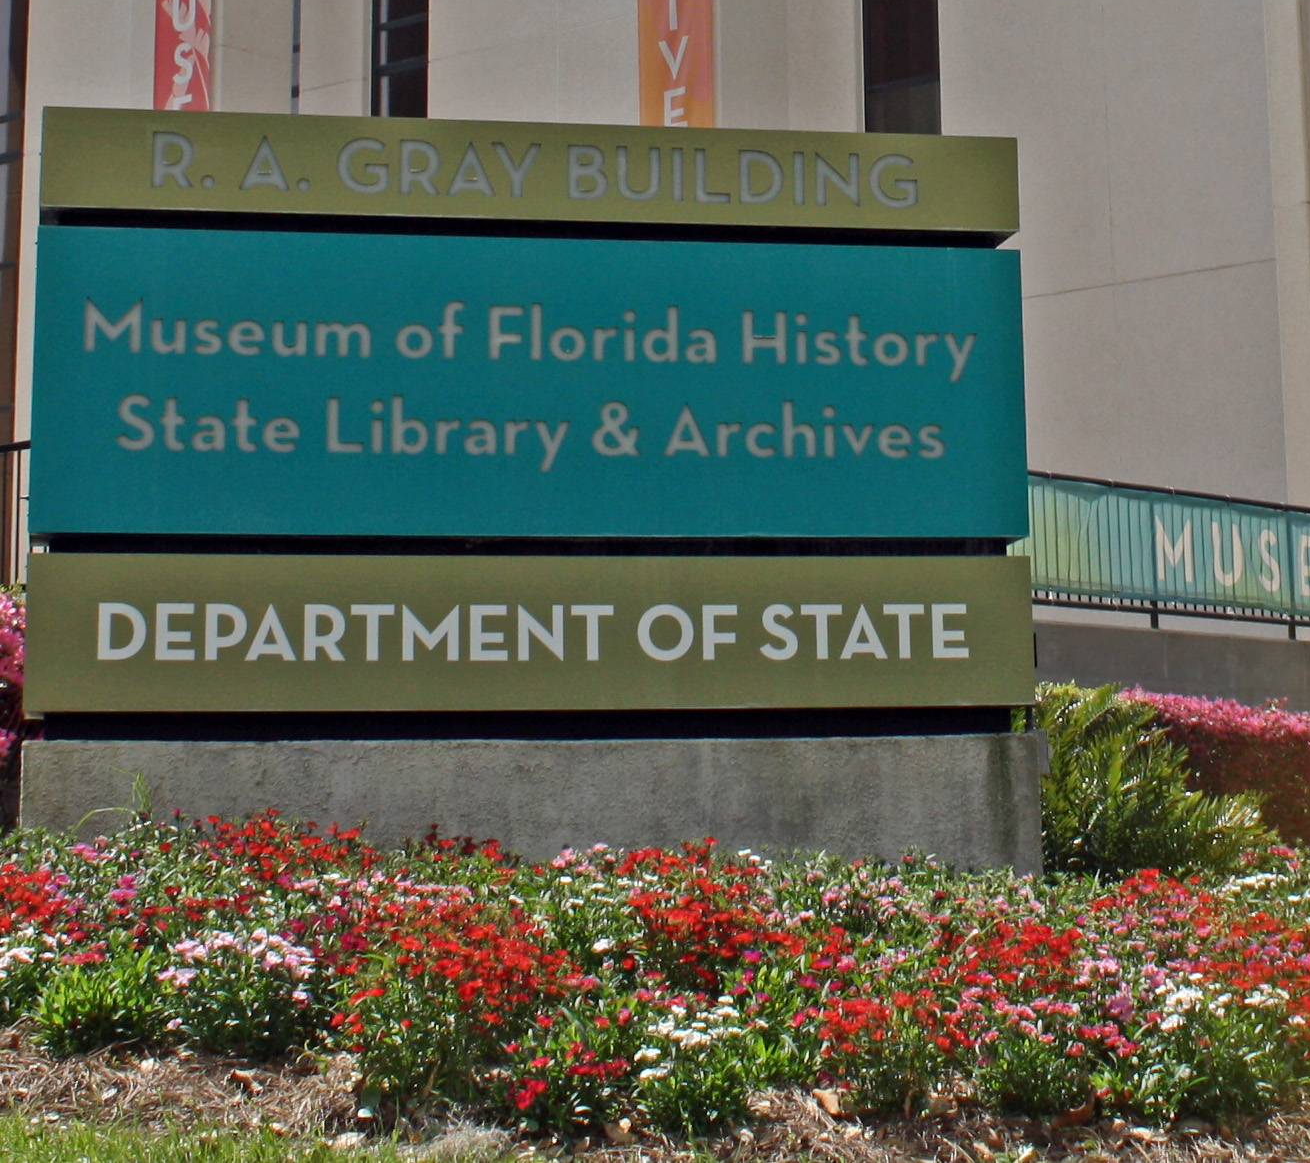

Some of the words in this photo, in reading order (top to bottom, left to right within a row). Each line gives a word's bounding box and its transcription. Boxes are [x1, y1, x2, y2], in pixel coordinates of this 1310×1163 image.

[150, 131, 214, 191] R.
[240, 135, 312, 194] A.
[337, 137, 543, 200] GRAY
[566, 145, 921, 210] BUILDING
[83, 296, 371, 358] Museum
[395, 300, 463, 359] of
[488, 302, 717, 366] Florida
[741, 309, 978, 382] History
[116, 394, 300, 453] State
[326, 396, 569, 471] Library
[592, 402, 643, 458] &
[665, 402, 945, 461] Archives
[97, 602, 614, 663] DEPARTMENT
[637, 603, 738, 663] OF
[760, 603, 969, 662] STATE
